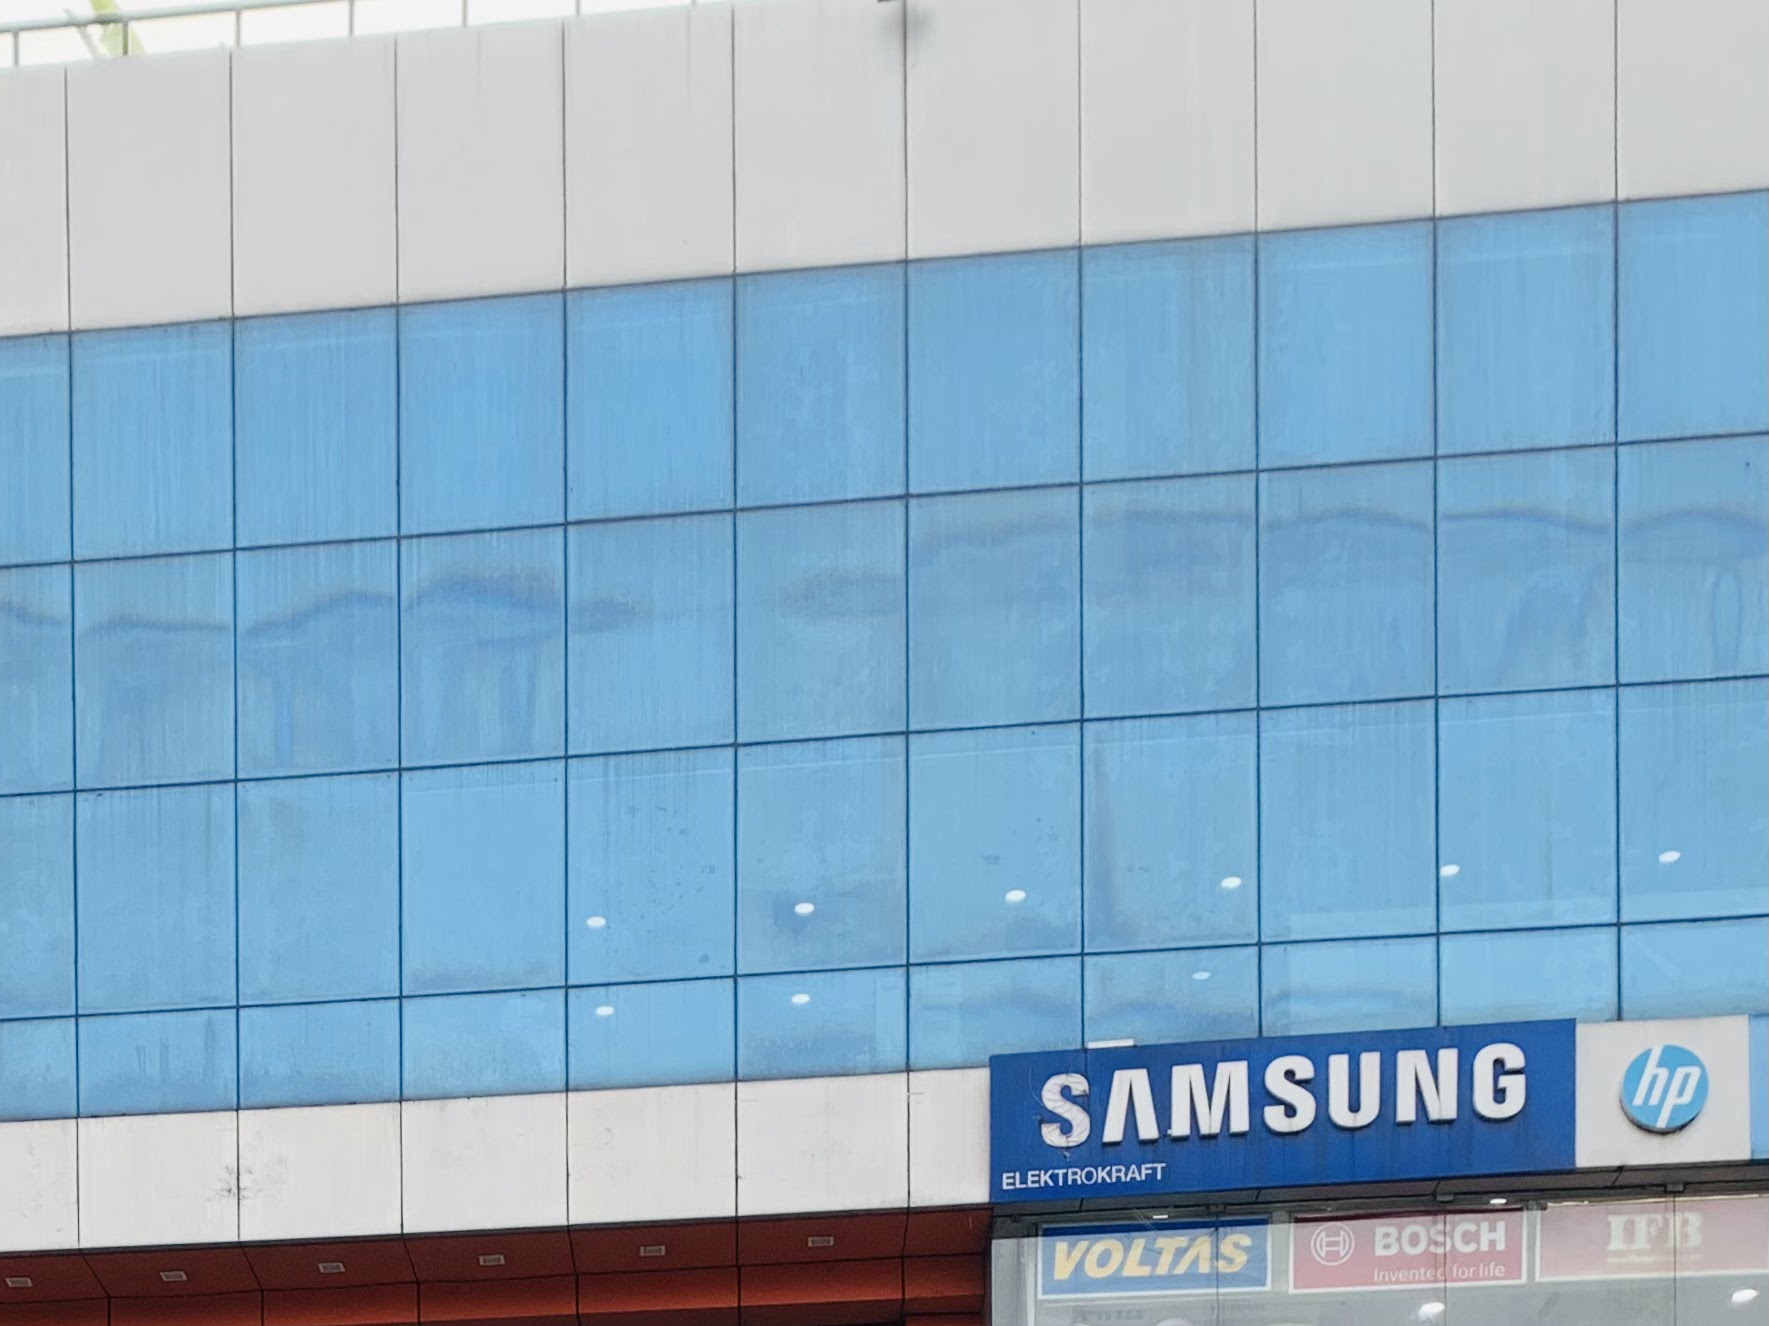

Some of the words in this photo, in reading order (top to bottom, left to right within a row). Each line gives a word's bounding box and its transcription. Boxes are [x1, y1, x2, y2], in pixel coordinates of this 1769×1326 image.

[1038, 1041, 1527, 1149] SAMSUNG
[1631, 1044, 1702, 1131] hp
[1001, 1161, 1167, 1191] ELEKTROKRAFT
[1373, 1221, 1507, 1257] BOSCH
[1607, 1211, 1705, 1250] IFB
[1052, 1233, 1252, 1282] VOLTAS
[1373, 1264, 1445, 1284] Invented
[1451, 1264, 1472, 1280] for
[1476, 1261, 1506, 1279] life
